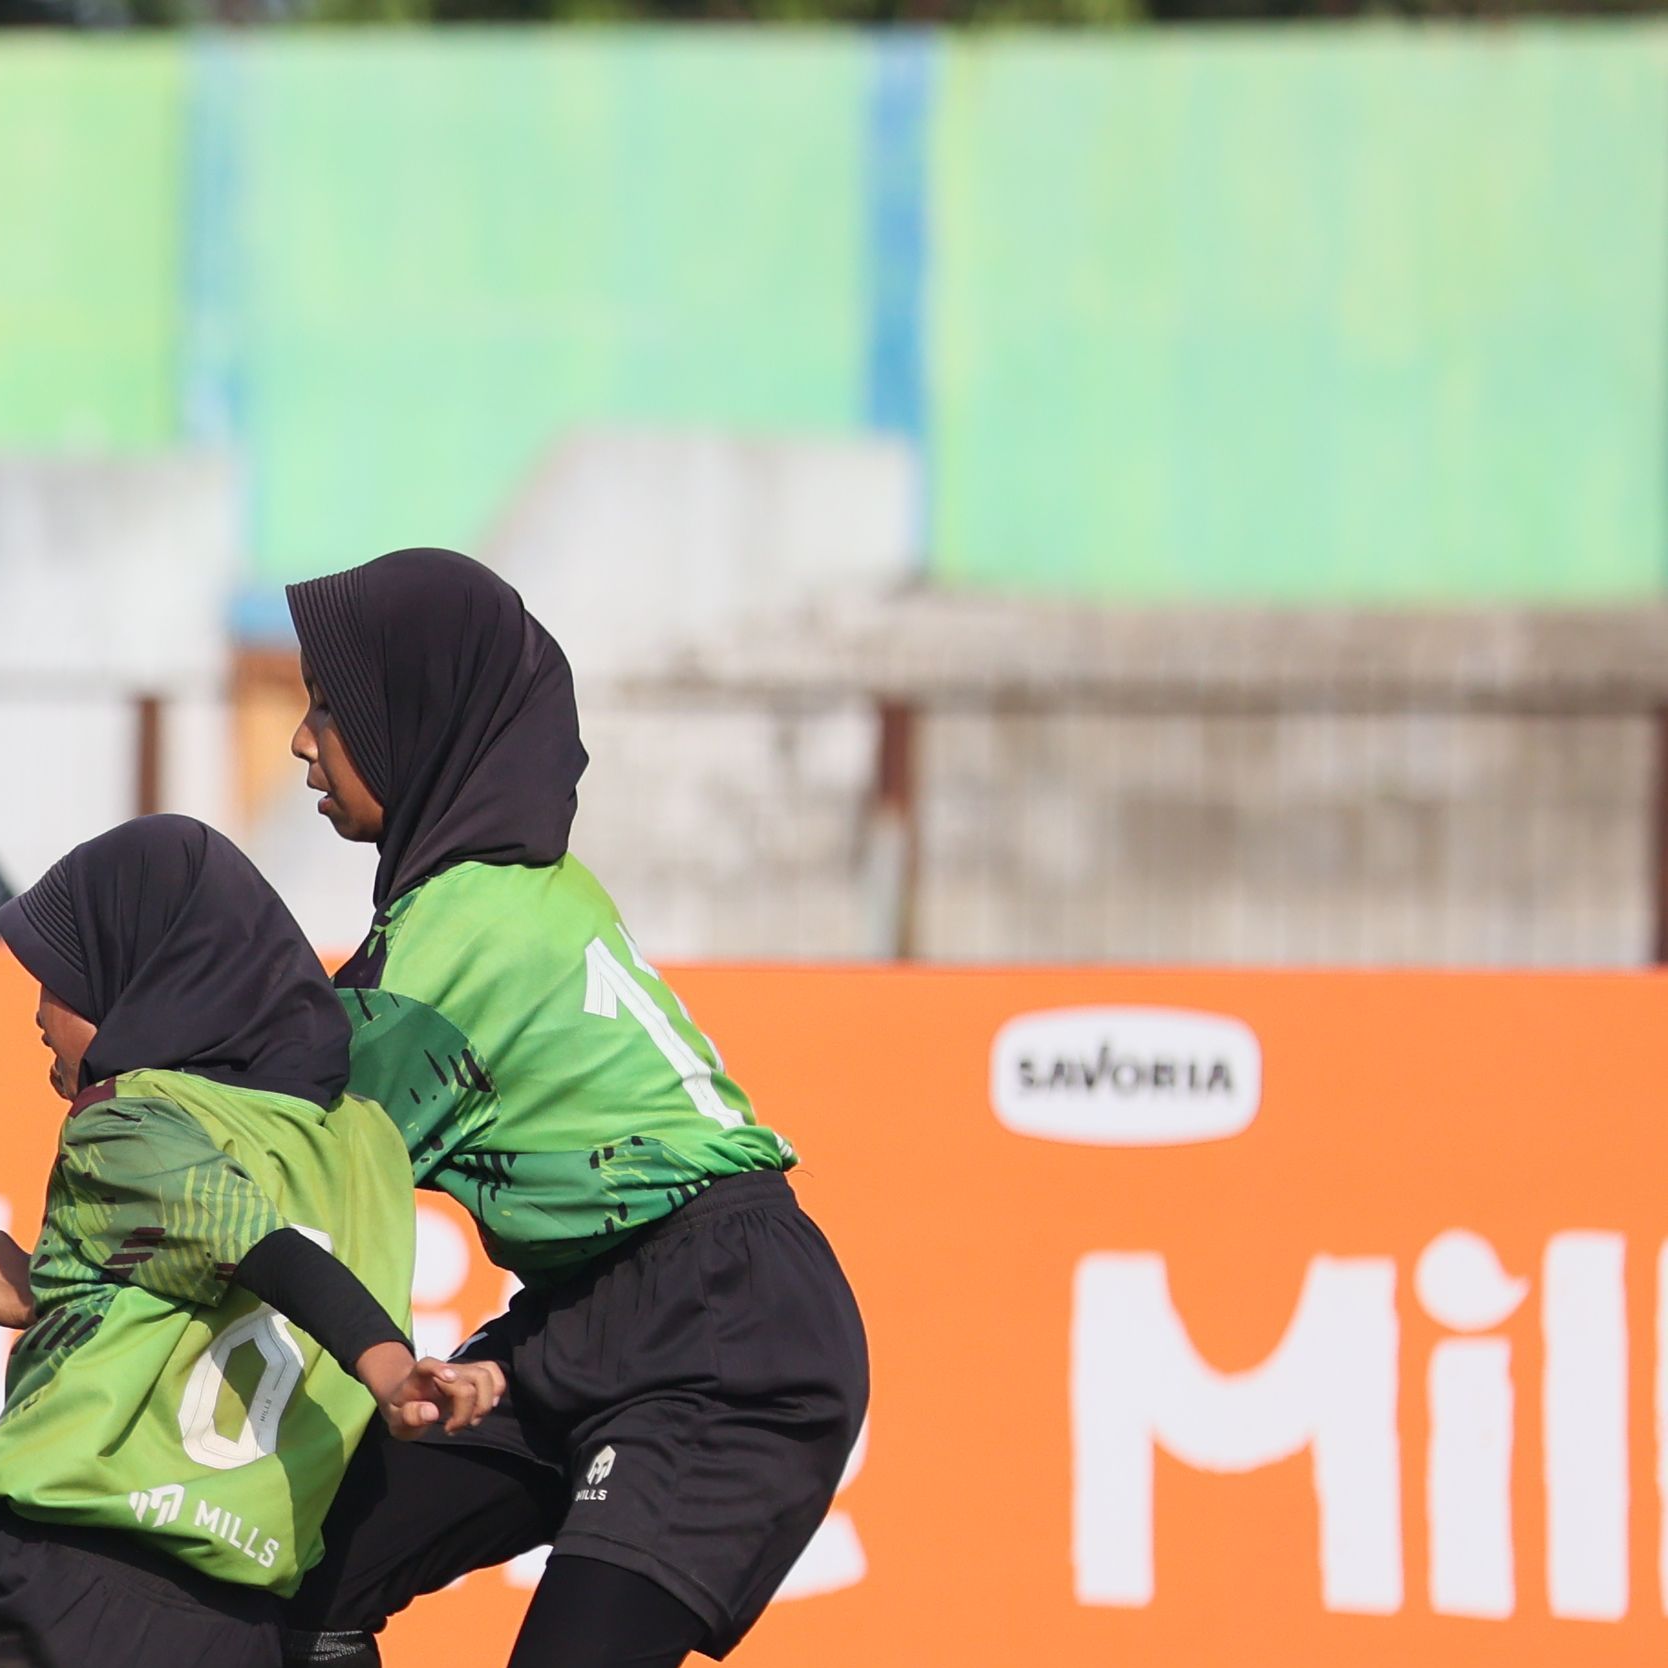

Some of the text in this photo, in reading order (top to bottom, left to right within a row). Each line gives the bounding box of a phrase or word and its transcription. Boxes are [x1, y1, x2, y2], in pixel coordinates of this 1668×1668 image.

[1019, 1040, 1234, 1093] SAVORIA
[1069, 1228, 1668, 1622] Mil
[575, 1489, 608, 1502] MILLS
[193, 1499, 280, 1569] MILLS
